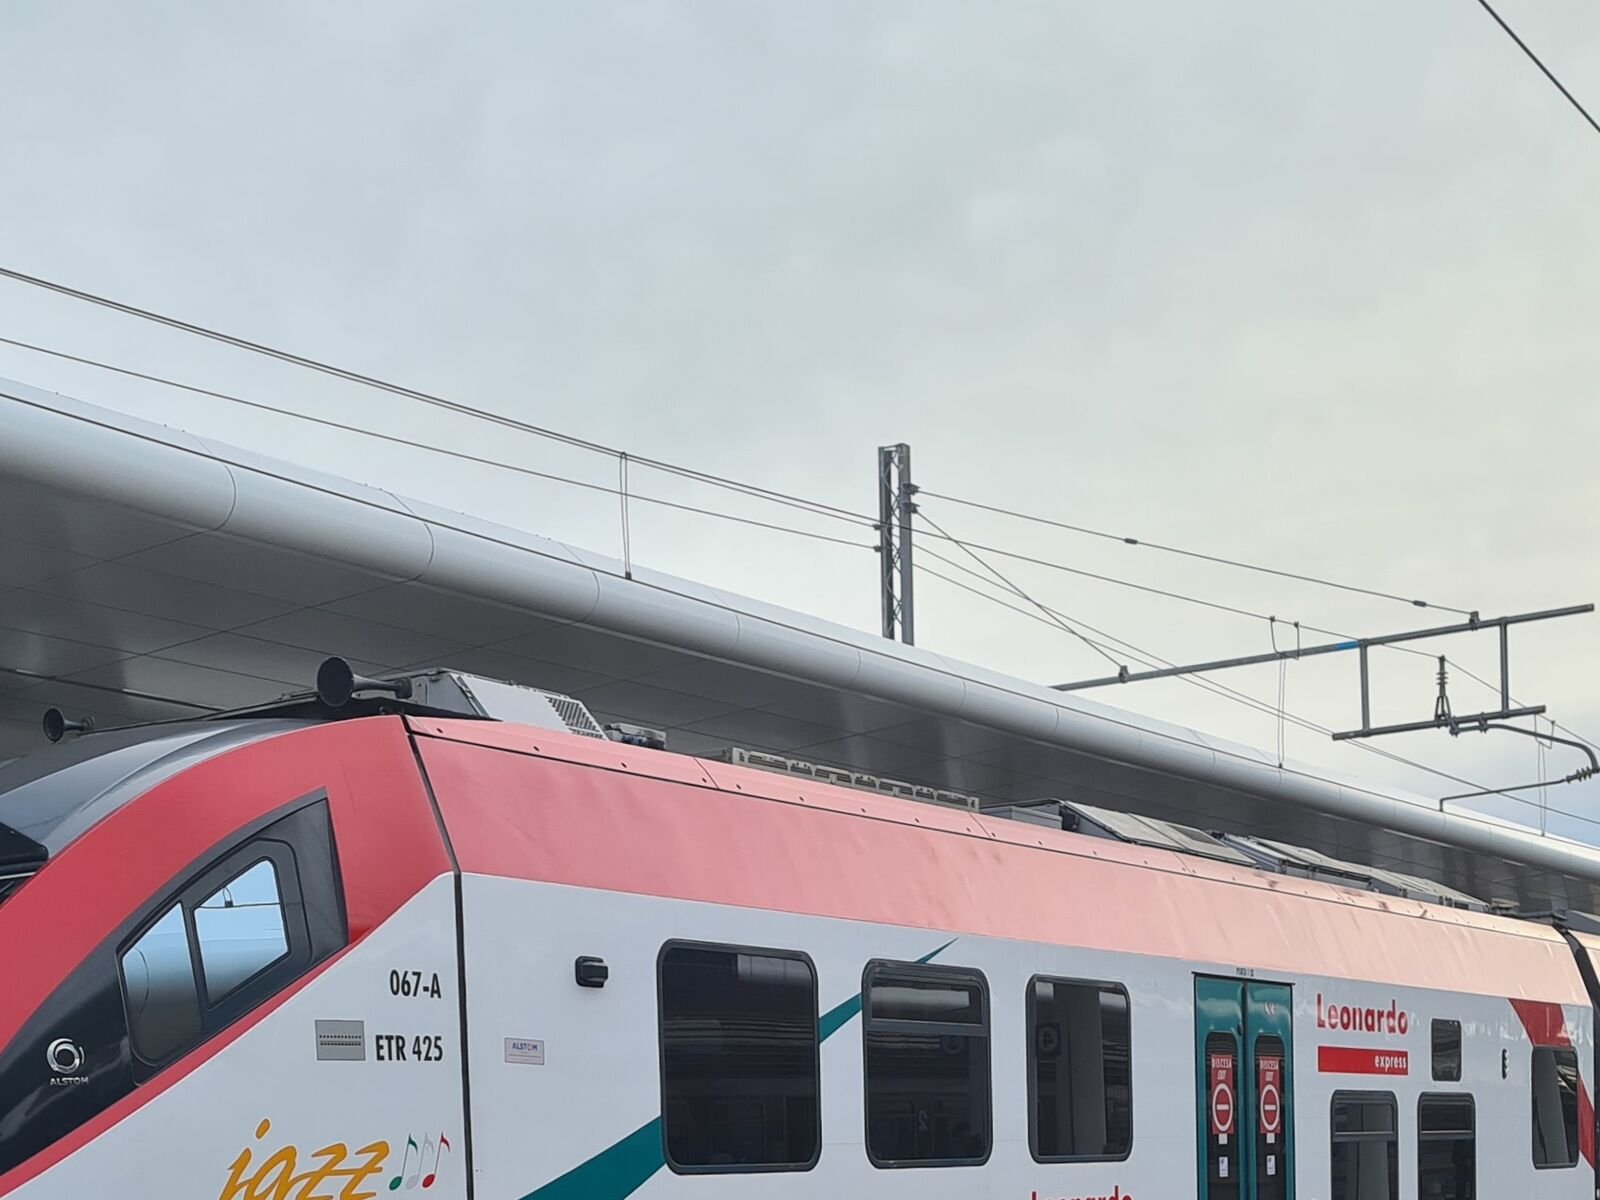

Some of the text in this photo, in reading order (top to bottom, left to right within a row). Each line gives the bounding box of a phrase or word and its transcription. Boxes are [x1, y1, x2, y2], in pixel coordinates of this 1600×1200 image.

[390, 969, 442, 999] 067-A
[1316, 992, 1408, 1035] Leonardo
[375, 1035, 407, 1061] ETR
[412, 1035, 443, 1061] 425
[1374, 1054, 1407, 1072] express
[50, 1076, 89, 1086] ALSTOM
